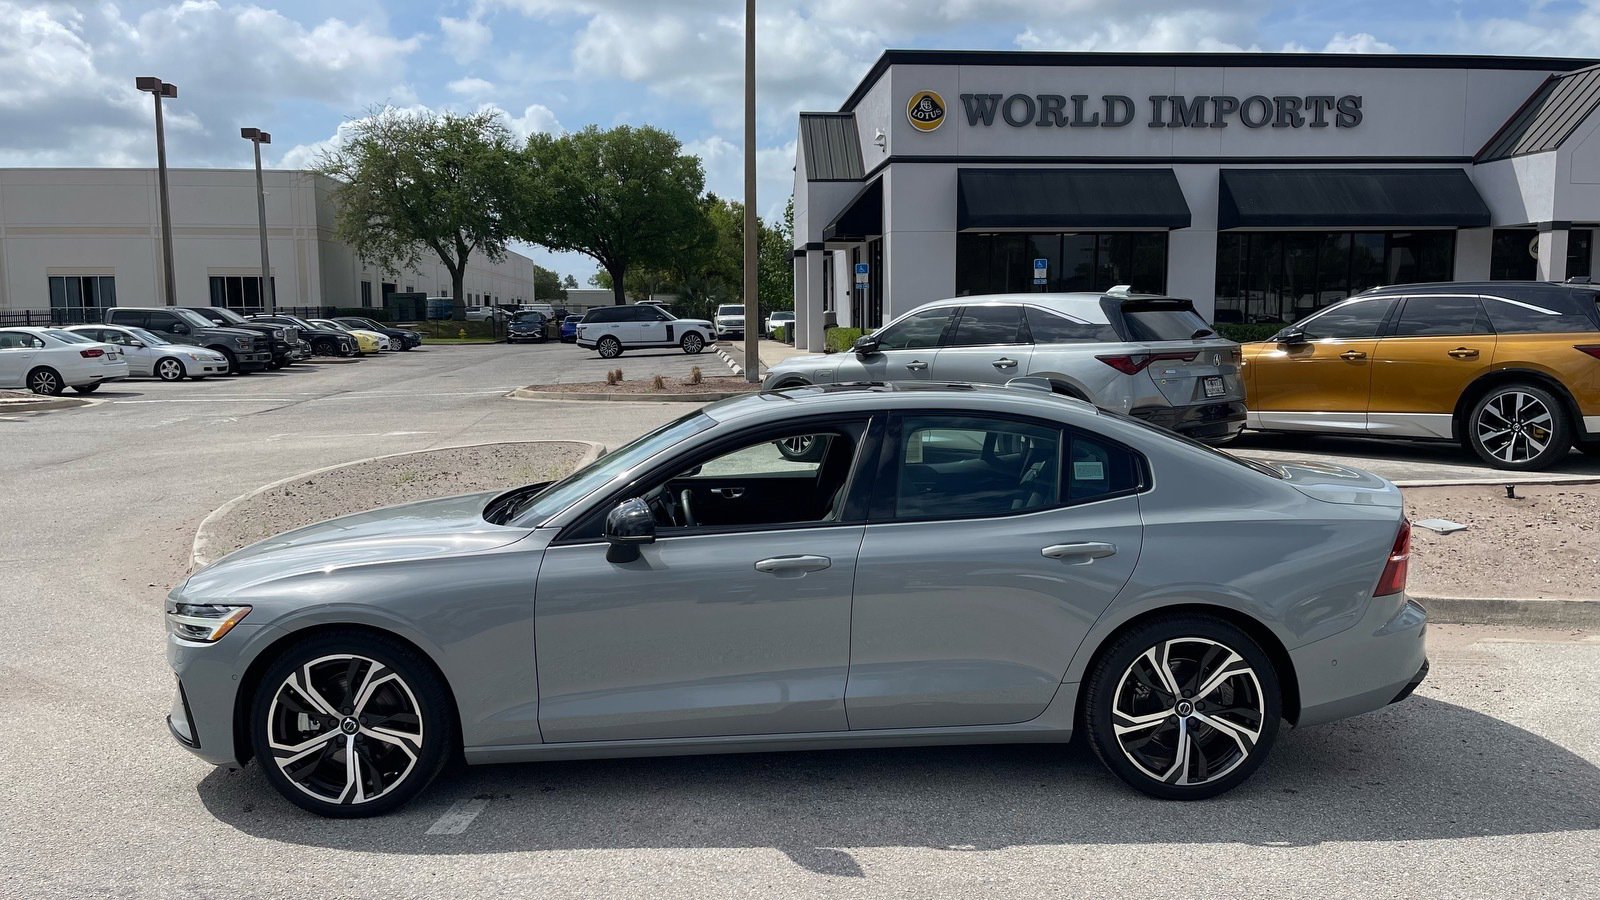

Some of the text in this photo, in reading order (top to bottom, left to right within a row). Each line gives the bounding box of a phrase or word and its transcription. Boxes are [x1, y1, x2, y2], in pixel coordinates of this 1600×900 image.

[912, 109, 942, 119] LOTUS
[960, 93, 1364, 129] WORLD IMPORTS
